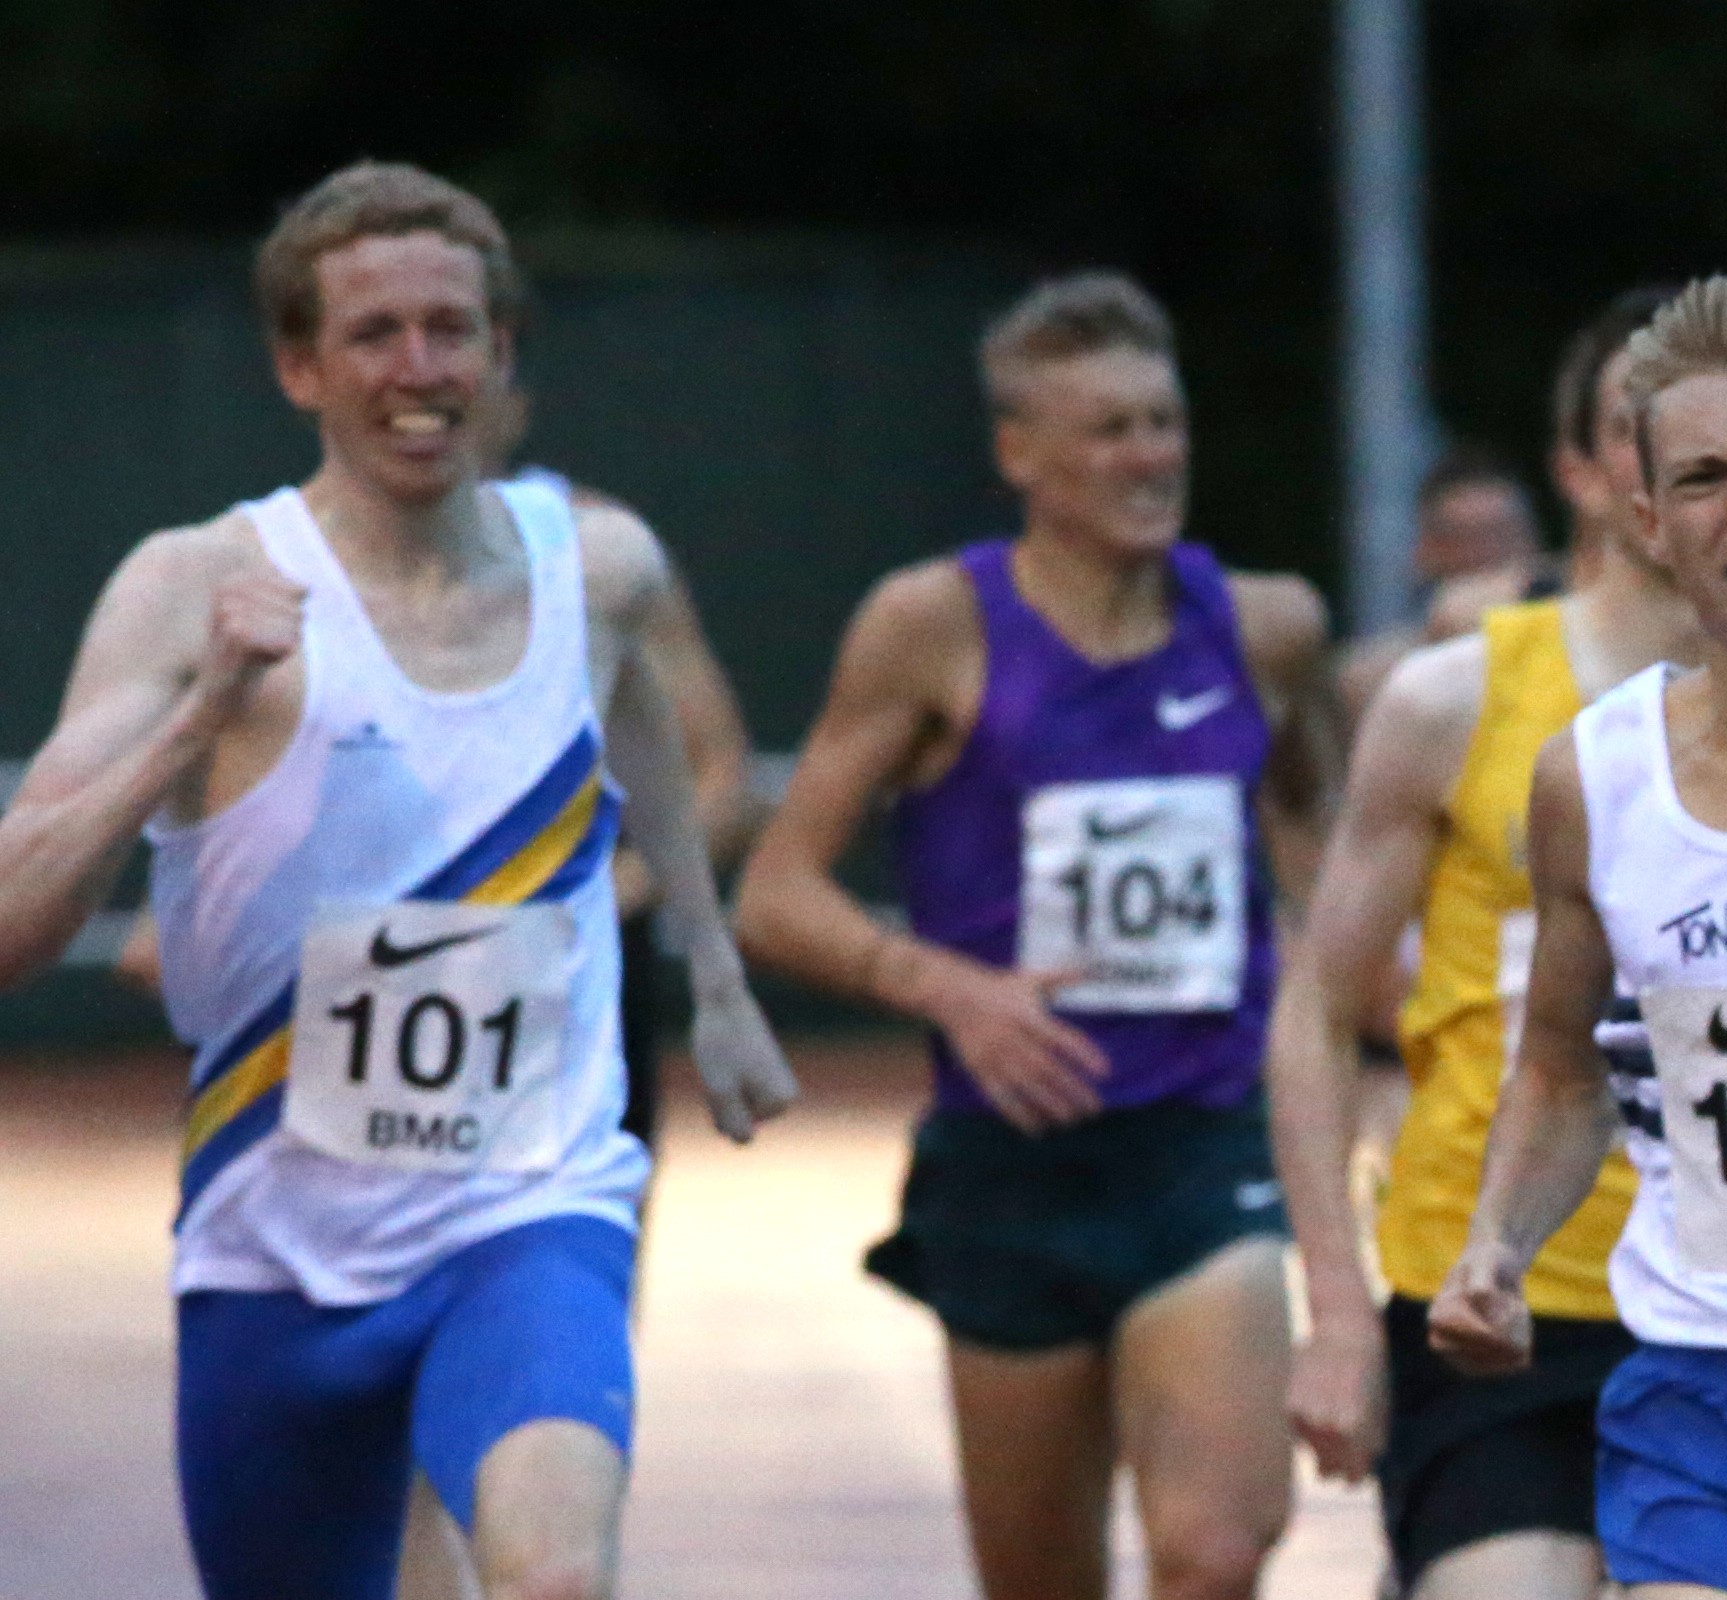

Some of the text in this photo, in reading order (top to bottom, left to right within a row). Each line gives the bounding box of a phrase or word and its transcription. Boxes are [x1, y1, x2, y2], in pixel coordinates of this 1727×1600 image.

[1056, 856, 1217, 945] 104
[328, 992, 523, 1089] 101
[366, 1109, 481, 1152] BMC
